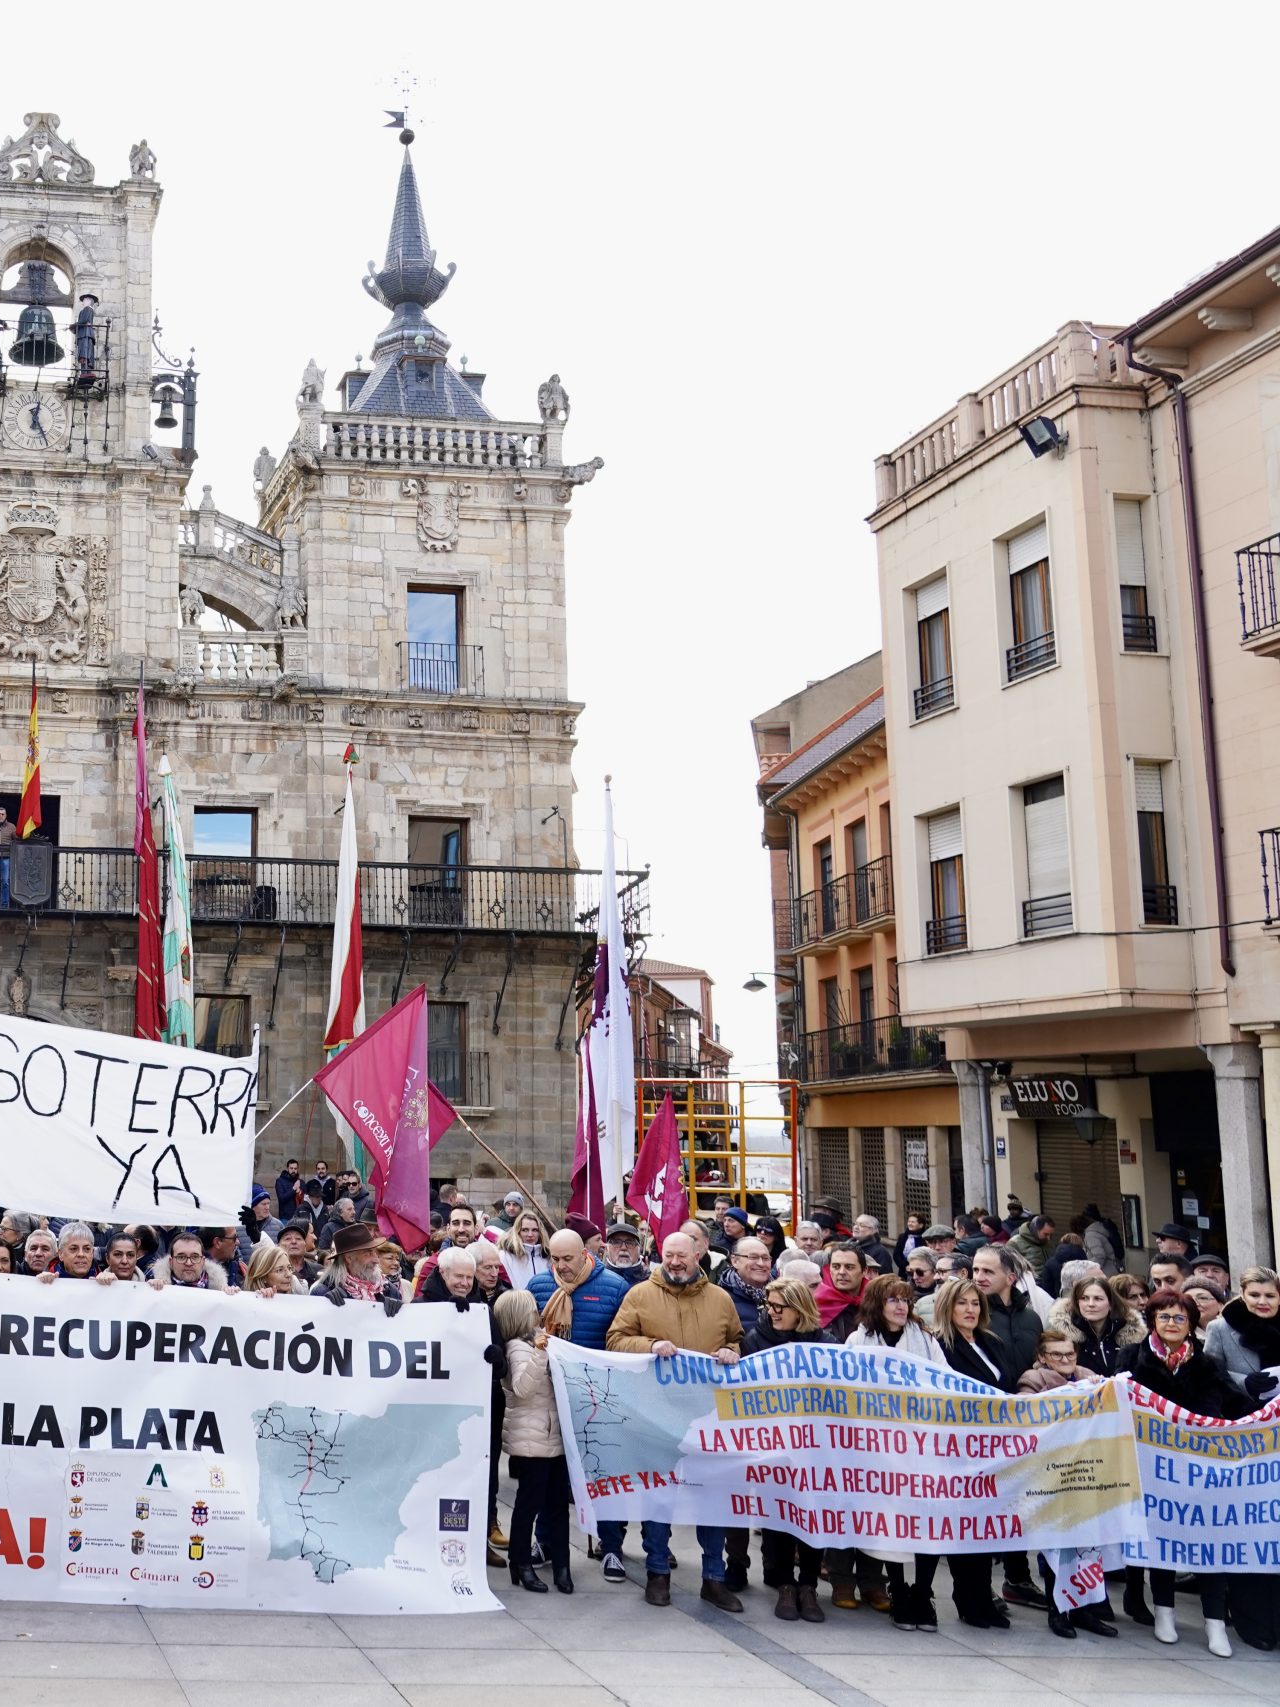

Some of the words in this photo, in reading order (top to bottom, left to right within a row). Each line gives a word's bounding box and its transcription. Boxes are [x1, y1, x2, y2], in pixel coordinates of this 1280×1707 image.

[96, 1134, 201, 1212] YA
[0, 1314, 353, 1377] RECUPERACIÓN
[368, 1341, 450, 1380] DEL
[741, 1388, 848, 1416] RECUPERAR
[854, 1391, 901, 1419] TREN
[907, 1394, 957, 1423] RUTA
[961, 1399, 983, 1424] DE
[987, 1399, 1012, 1424] LA
[1015, 1398, 1073, 1425] PLATA
[1, 1402, 64, 1448] LA
[79, 1406, 225, 1455] PLATA
[699, 1429, 727, 1453] LA
[729, 1426, 785, 1452] VEGA
[789, 1424, 820, 1450] DEL
[826, 1424, 907, 1454] TUERTO
[912, 1431, 928, 1455] Y
[933, 1432, 960, 1457] LA
[965, 1433, 1039, 1458] CEPEDA
[640, 1471, 667, 1489] YA
[746, 1465, 809, 1492] APOYA
[812, 1467, 837, 1492] LA
[842, 1467, 997, 1499] RECUPERACIÓN
[1155, 1454, 1180, 1484] EL
[731, 1494, 769, 1518] DEL
[774, 1498, 819, 1534] TREN
[823, 1509, 845, 1534] DE
[851, 1511, 887, 1537] VIA
[895, 1514, 920, 1539] DE
[928, 1515, 954, 1540] LA
[959, 1514, 1023, 1540] PLATA
[1212, 1503, 1238, 1527] LA
[66, 1562, 118, 1576] Cámara
[1156, 1537, 1216, 1567] TREN
[1221, 1542, 1249, 1567] DE
[130, 1567, 179, 1582] Cámara
